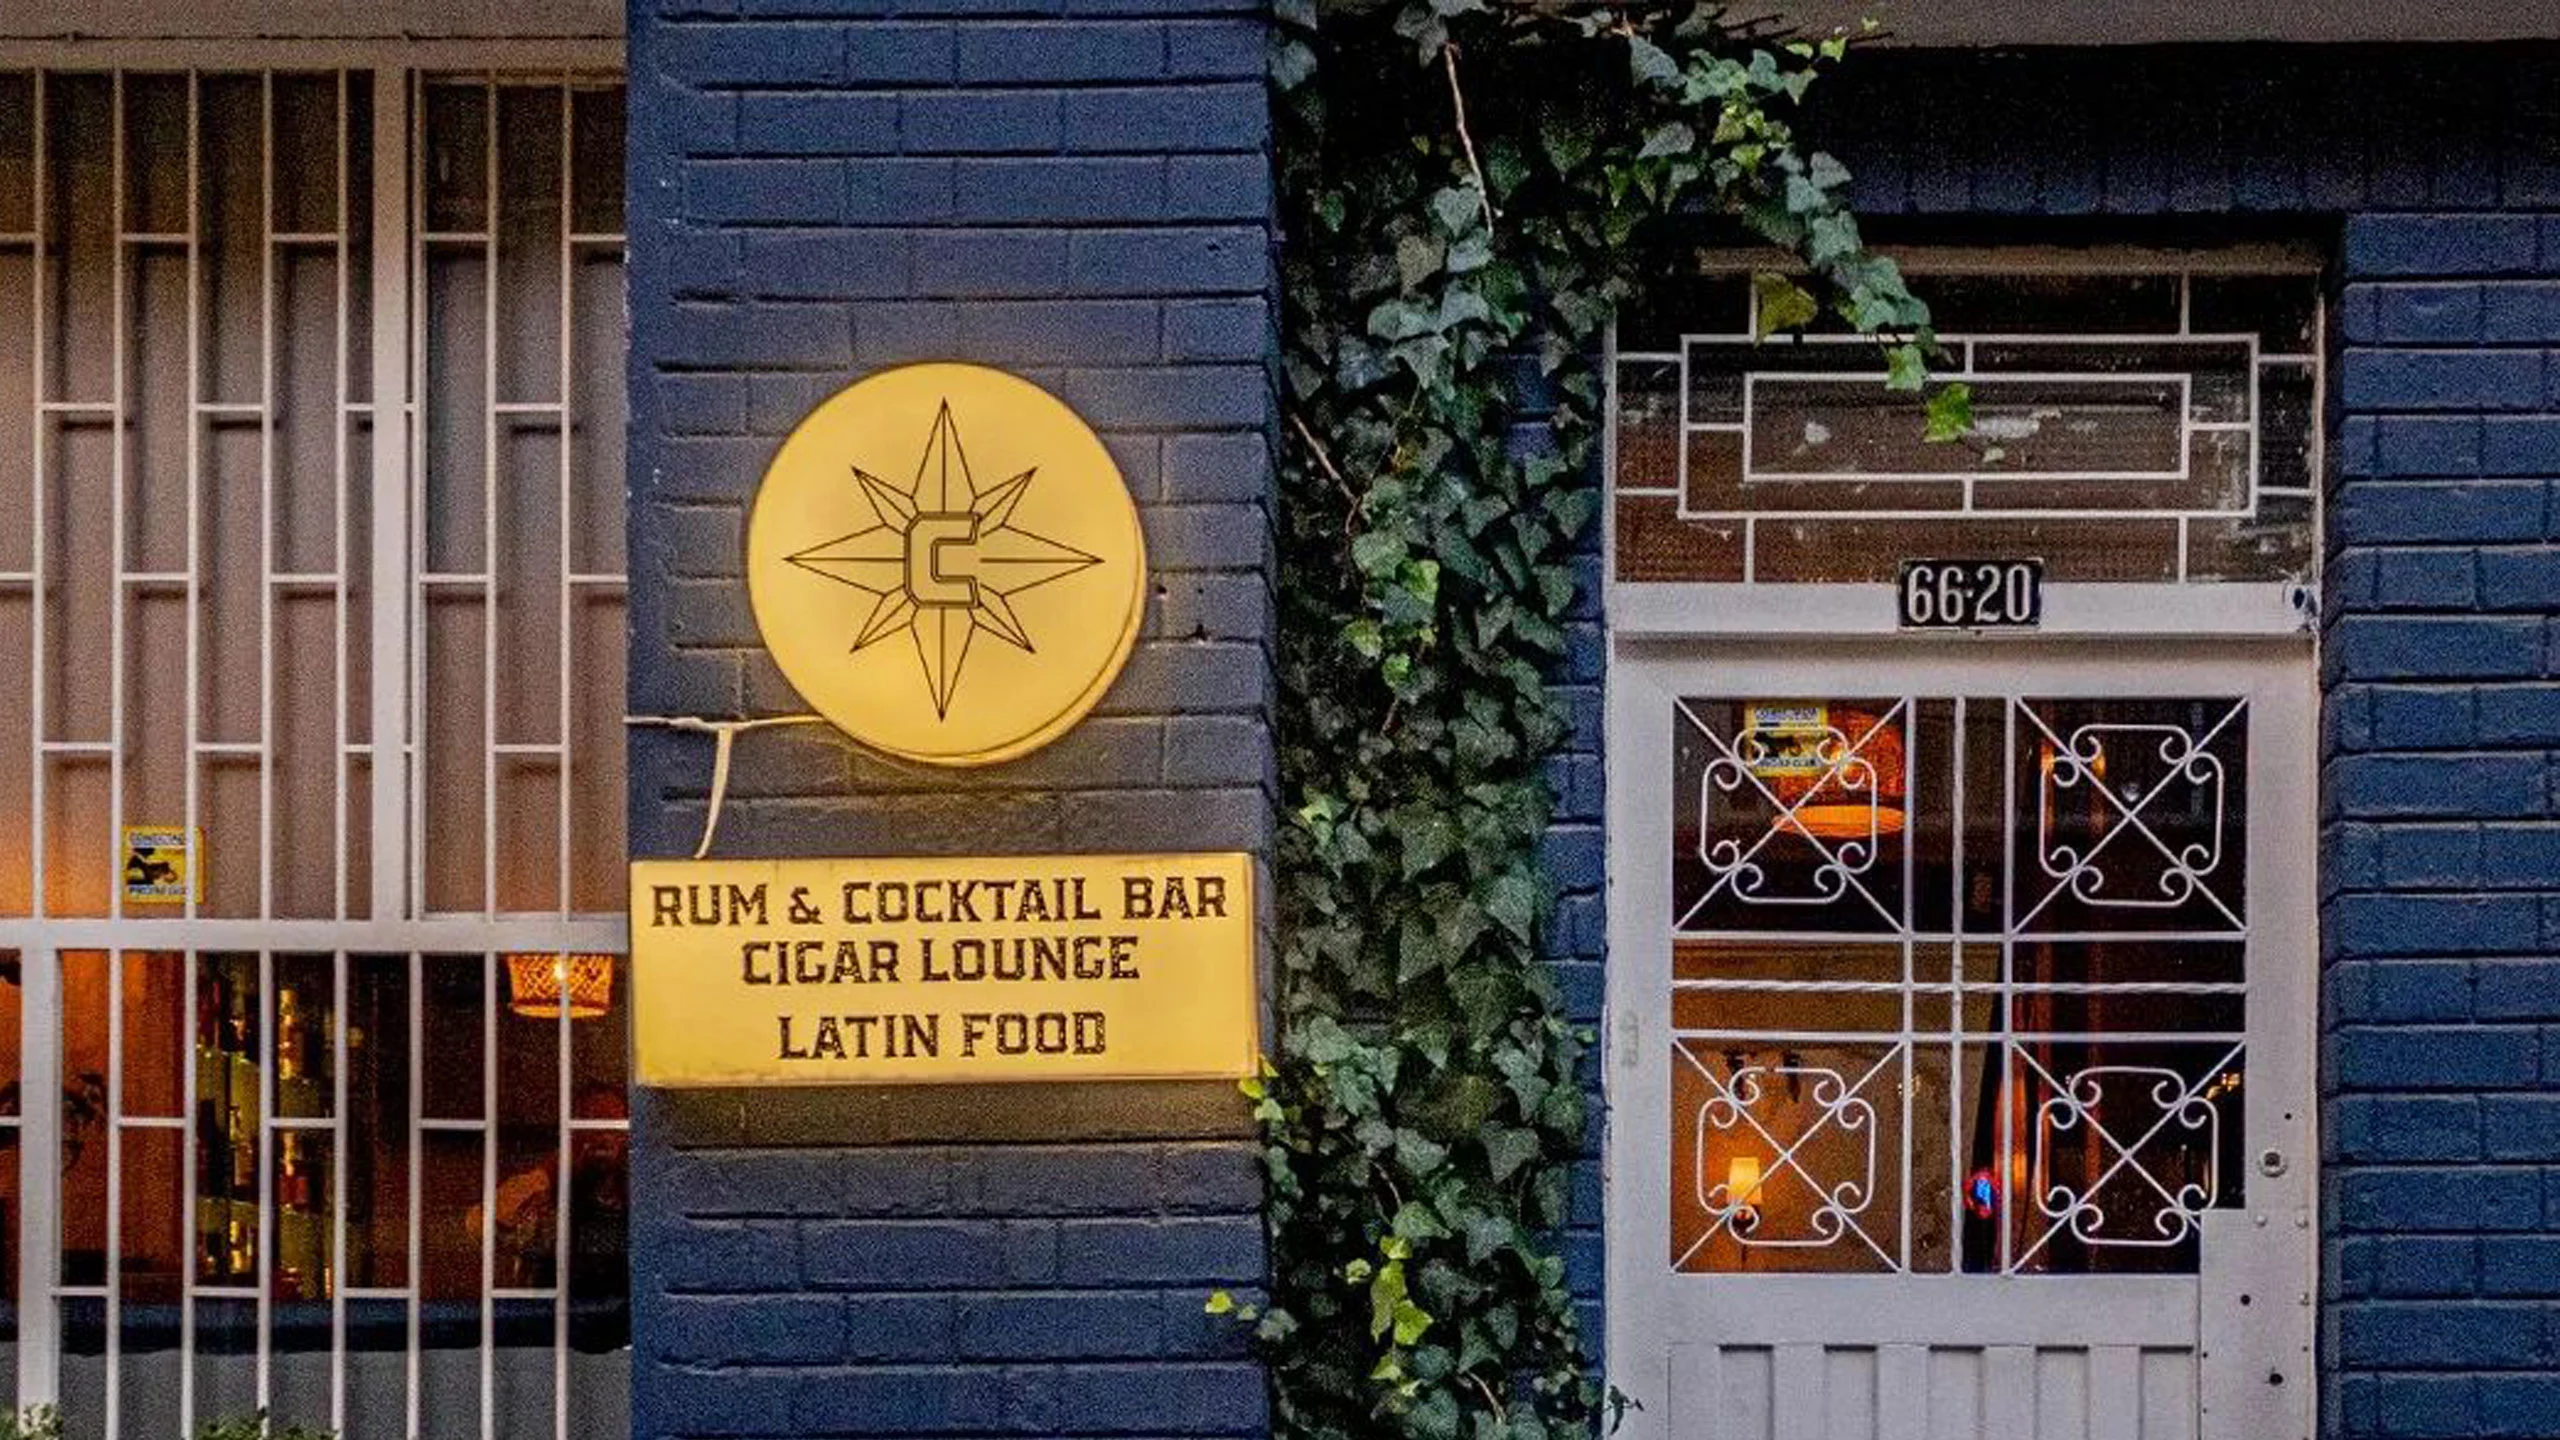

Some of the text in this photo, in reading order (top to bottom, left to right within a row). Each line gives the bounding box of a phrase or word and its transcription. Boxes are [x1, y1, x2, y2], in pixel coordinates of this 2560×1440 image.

[904, 512, 982, 609] C
[652, 875, 1228, 926] RUM & COCKTAIL BAR
[741, 935, 1140, 985] CIGAR LOUNGE
[777, 1010, 1106, 1060] LATIN FOOD
